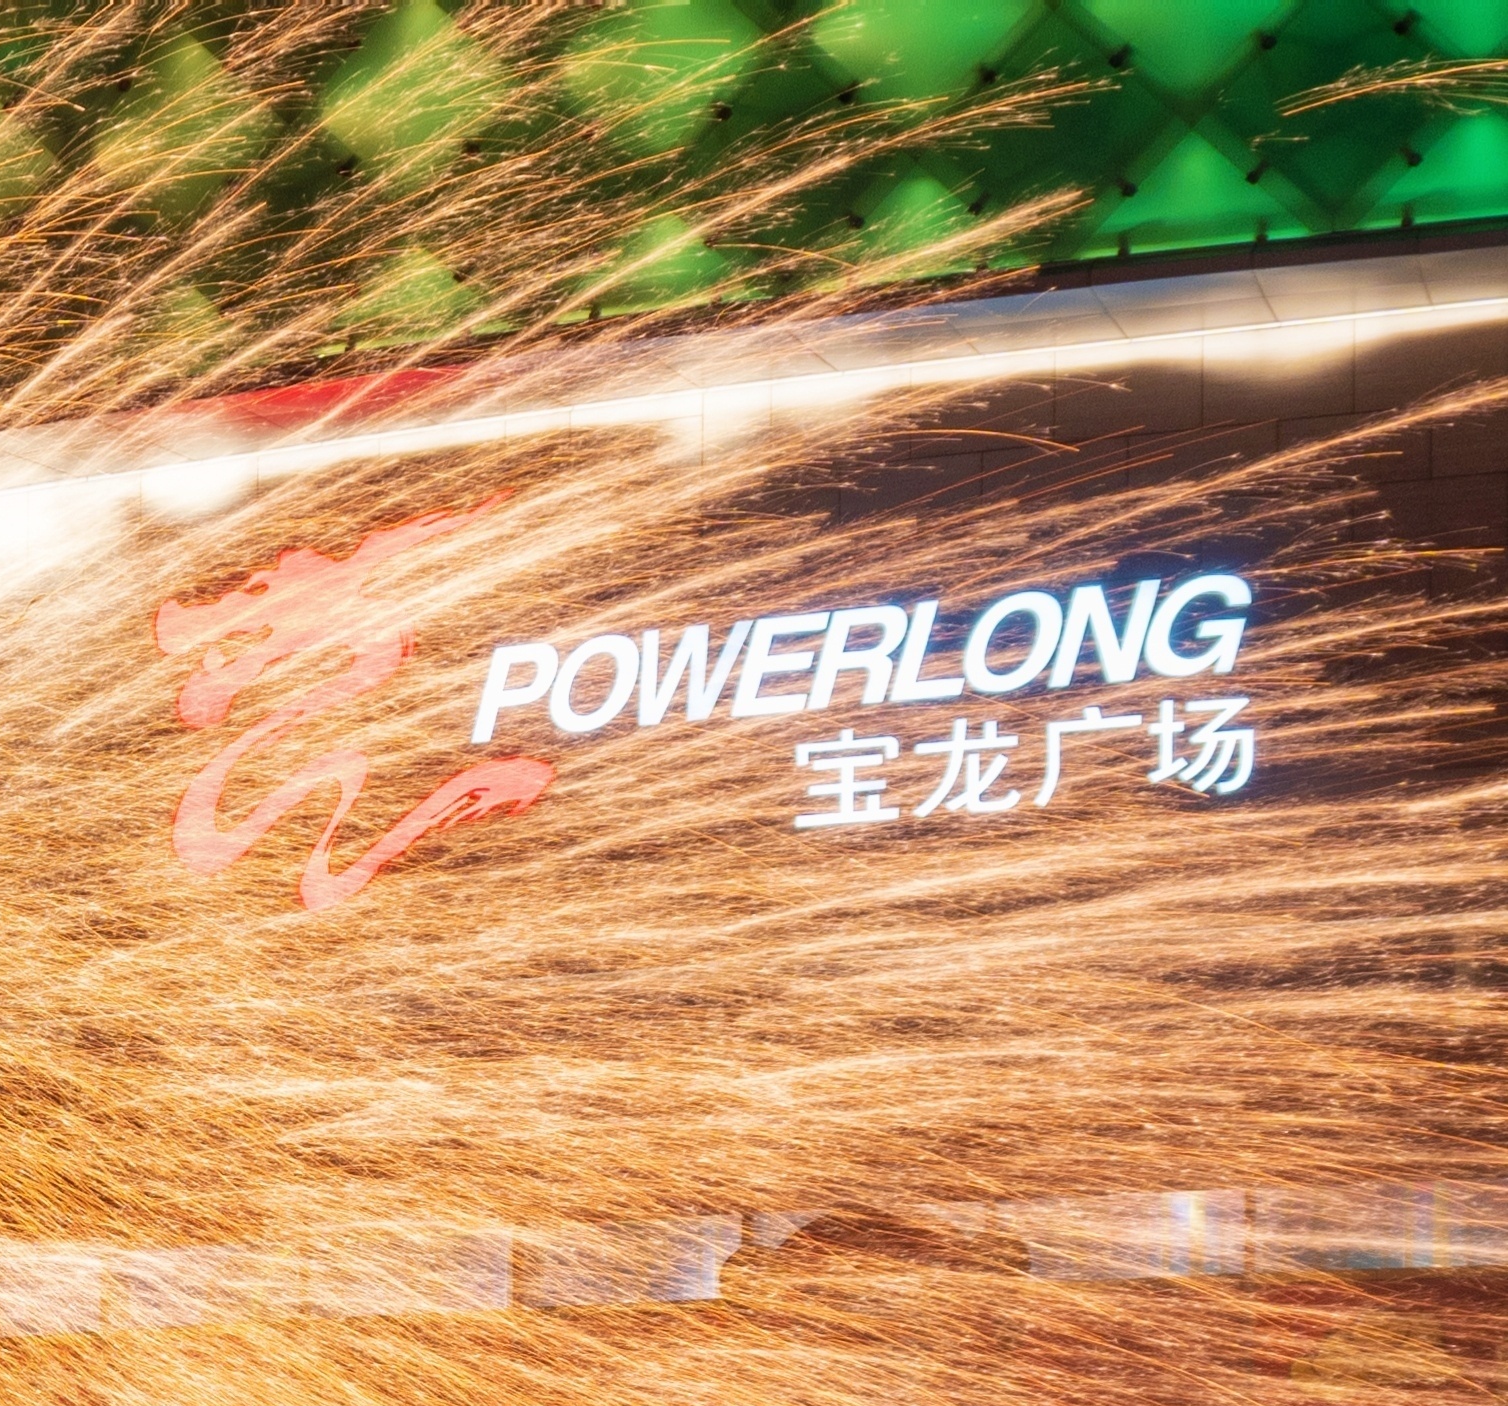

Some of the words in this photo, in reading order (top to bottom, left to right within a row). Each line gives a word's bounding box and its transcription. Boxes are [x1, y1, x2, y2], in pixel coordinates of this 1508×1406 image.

[472, 574, 1252, 743] POWERLONG
[795, 696, 1255, 828] 宝龙广场
